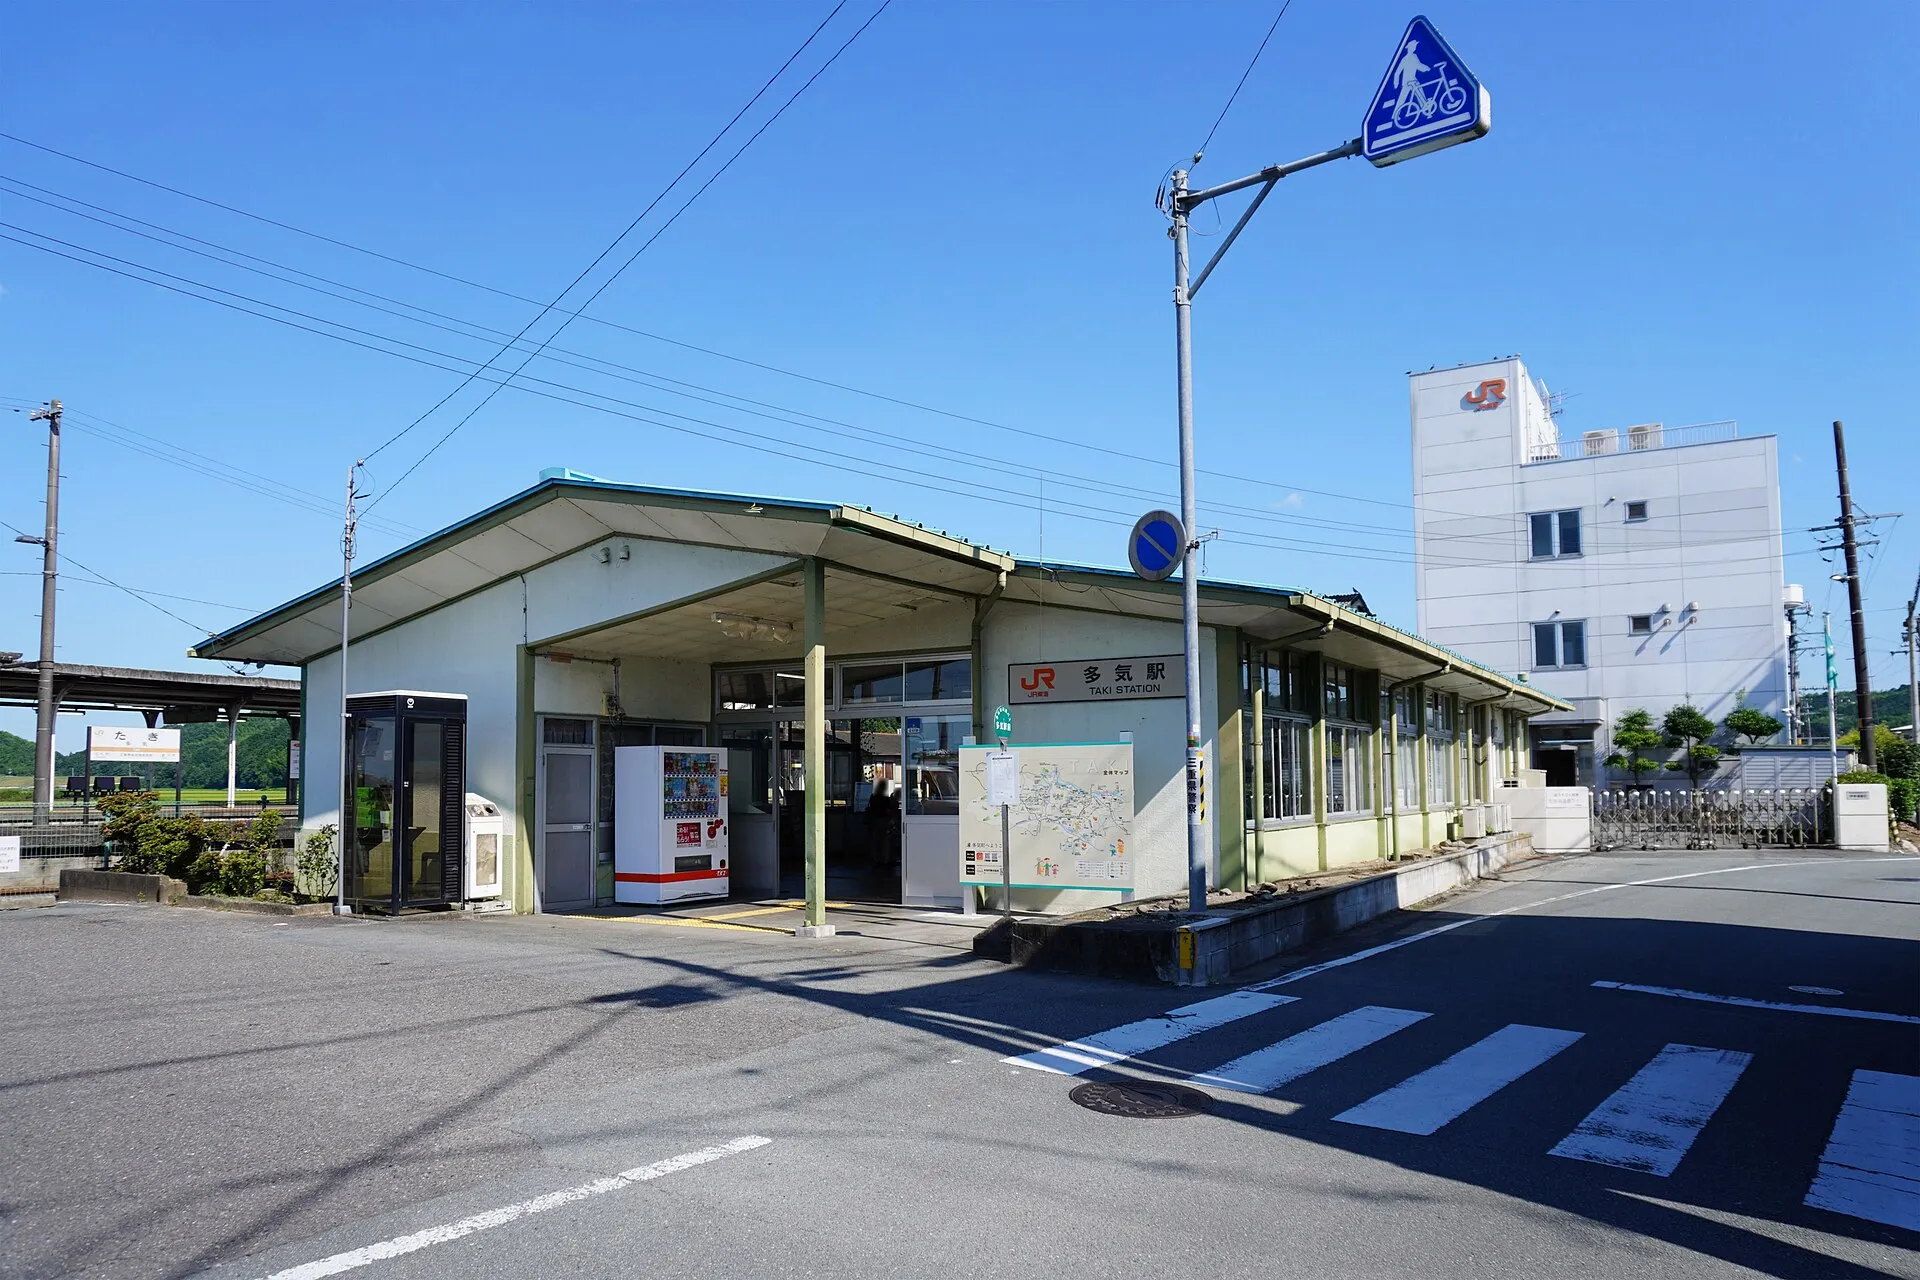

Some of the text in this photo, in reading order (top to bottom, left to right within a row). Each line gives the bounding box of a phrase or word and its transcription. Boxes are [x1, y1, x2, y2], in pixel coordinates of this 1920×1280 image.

[1466, 379, 1506, 403] JR
[1021, 668, 1055, 690] JR
[1083, 662, 1165, 684] 多気駅
[1089, 684, 1161, 695] TAKI STATION
[1187, 757, 1197, 814] 三重県警察
